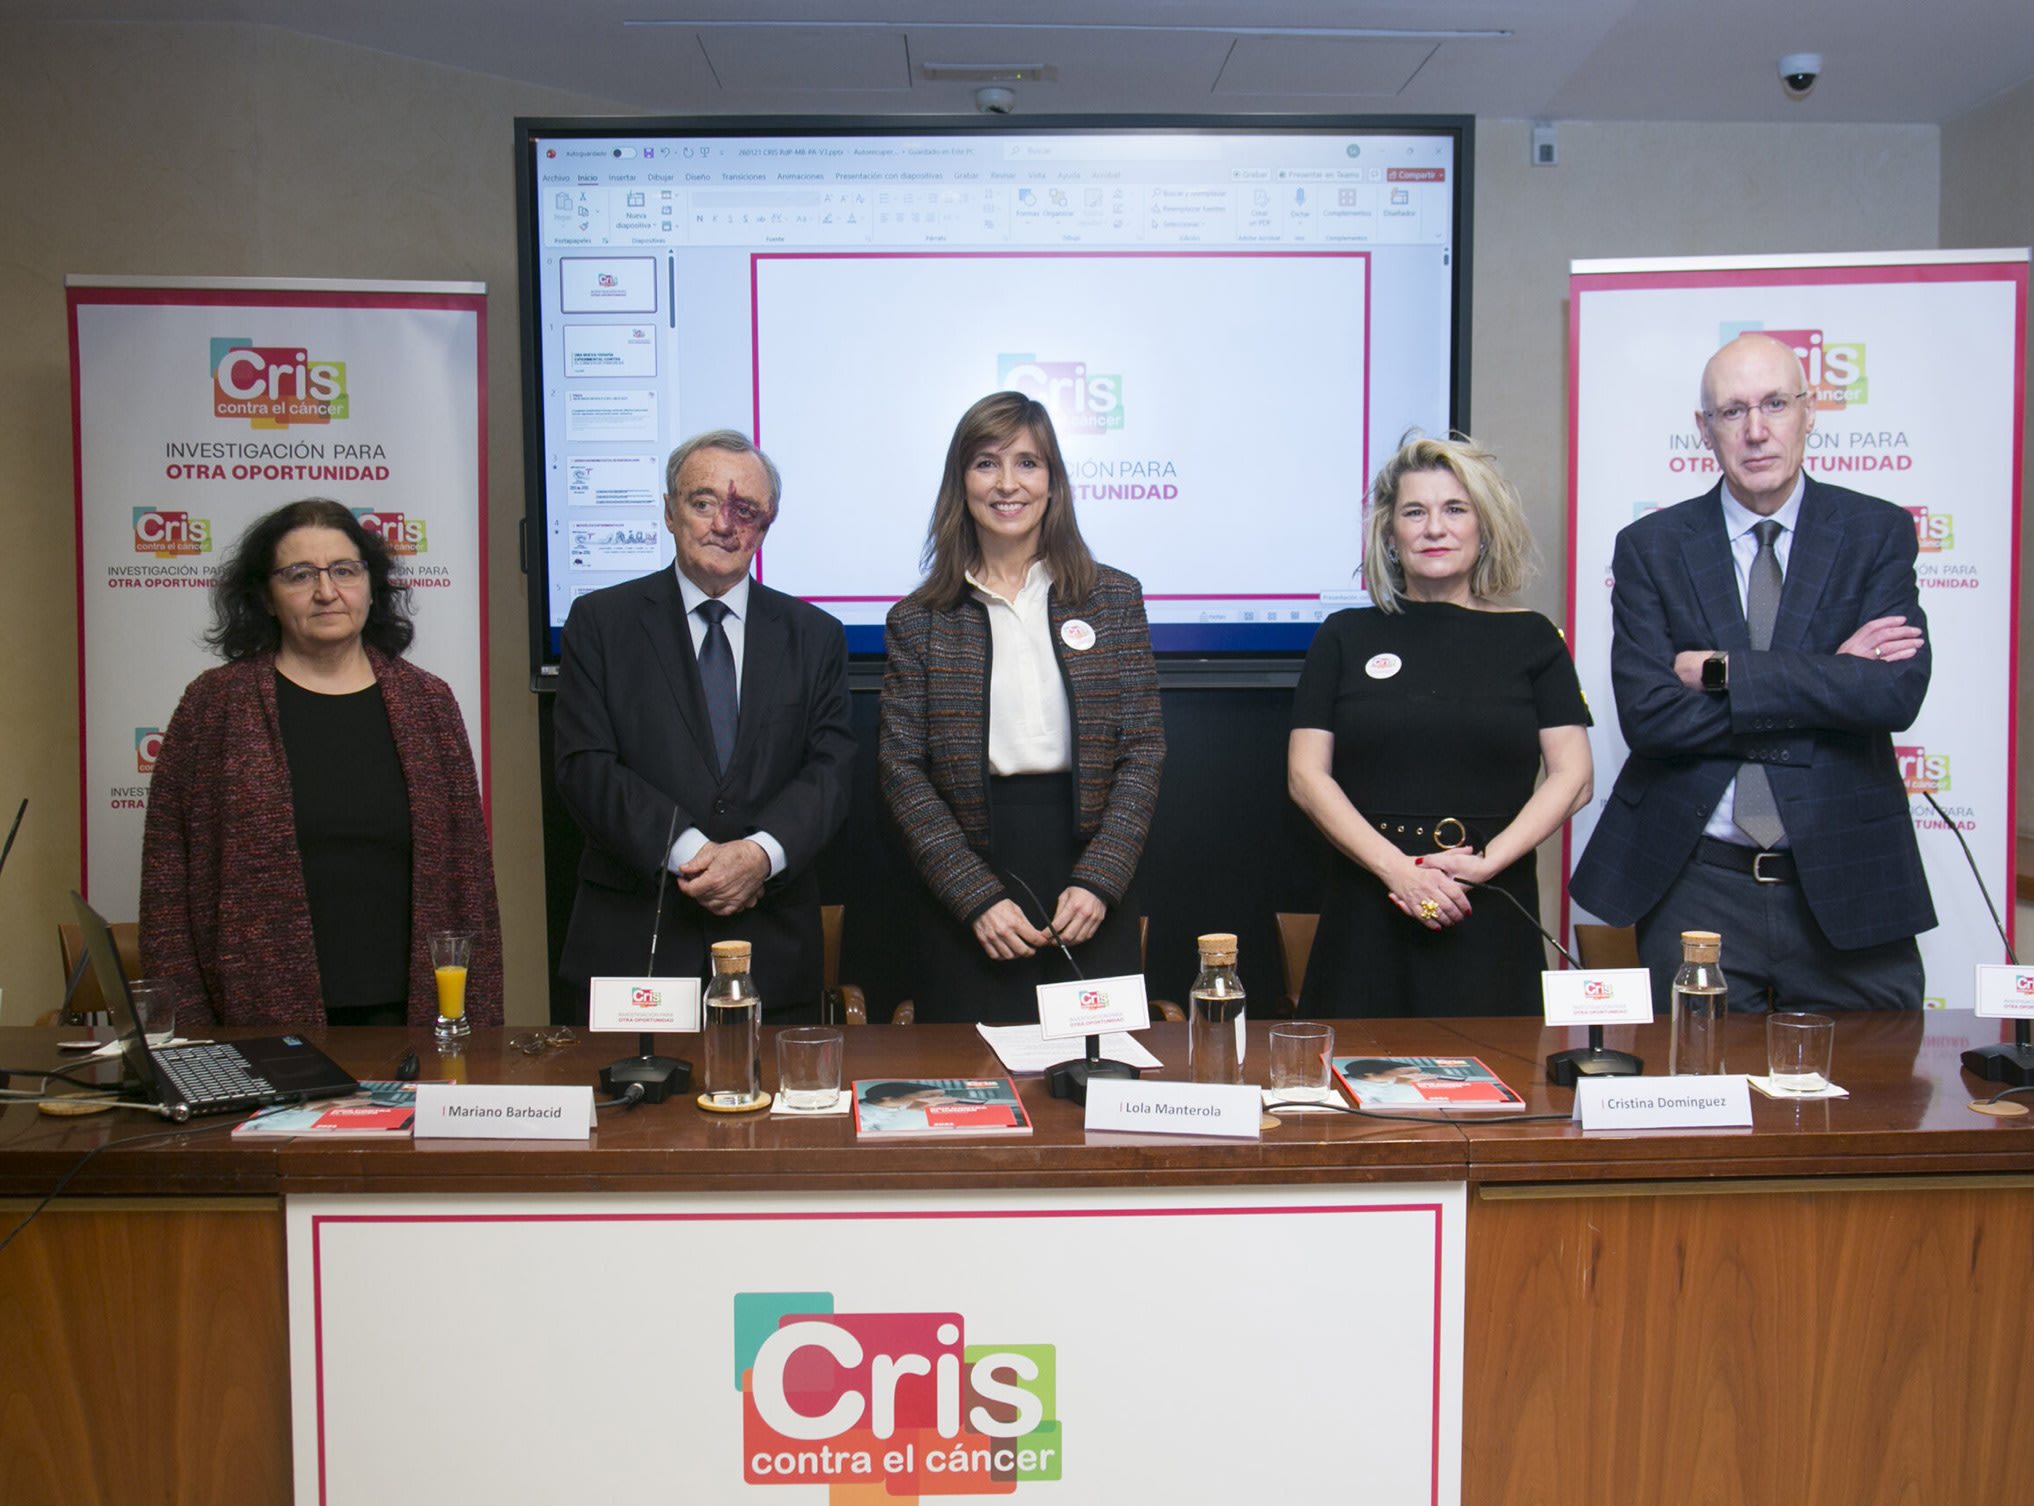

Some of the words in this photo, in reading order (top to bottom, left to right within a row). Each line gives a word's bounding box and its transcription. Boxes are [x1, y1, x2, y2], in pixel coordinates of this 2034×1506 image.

[542, 174, 570, 182] Archivo
[577, 174, 598, 182] Inicio
[609, 173, 637, 182] Insertar
[648, 173, 674, 182] Dibujar
[685, 173, 711, 181] Diseño
[722, 173, 766, 181] Transiciones
[777, 172, 824, 180] Animaciones
[835, 172, 883, 180] Presentación
[900, 172, 943, 181] diapositivas
[1398, 171, 1435, 180] Compartir
[218, 350, 342, 401] Cris
[1815, 386, 1863, 401] áncer
[217, 401, 269, 415] contra
[272, 400, 286, 415] el
[289, 400, 344, 416] cáncer
[1850, 432, 1910, 449] PARA
[166, 441, 325, 460] INVESTIGACIÓN
[334, 444, 386, 460] PARA
[1805, 455, 1913, 472] TUNIDAD
[166, 464, 226, 480] OTRA
[232, 465, 390, 481] OPORTUNIDAD
[1120, 461, 1177, 478] PARA
[1071, 484, 1179, 500] TUNIDAD
[137, 513, 208, 542] Cris
[137, 542, 166, 550] contra
[167, 542, 175, 550] el
[108, 564, 198, 576] INVESTIGACIÓN
[203, 566, 227, 576] PAR
[419, 566, 449, 576] PARA
[1943, 564, 1978, 575] PARA
[108, 578, 142, 588] OTRA
[390, 578, 451, 588] TUNIDAD
[1919, 579, 1979, 588] TUNIDAD
[1898, 748, 1947, 780] ris
[111, 799, 145, 809] OTRA
[633, 989, 661, 1002] Cris
[1607, 1098, 1654, 1109] Cristina
[449, 1105, 502, 1118] Mariano
[506, 1106, 562, 1119] Barbacid
[1126, 1102, 1151, 1114] Lola
[1155, 1103, 1221, 1117] Manterola
[752, 1321, 1043, 1440] Cris
[751, 1445, 872, 1474] contra
[883, 1443, 914, 1473] el
[926, 1443, 1055, 1472] cáncer
